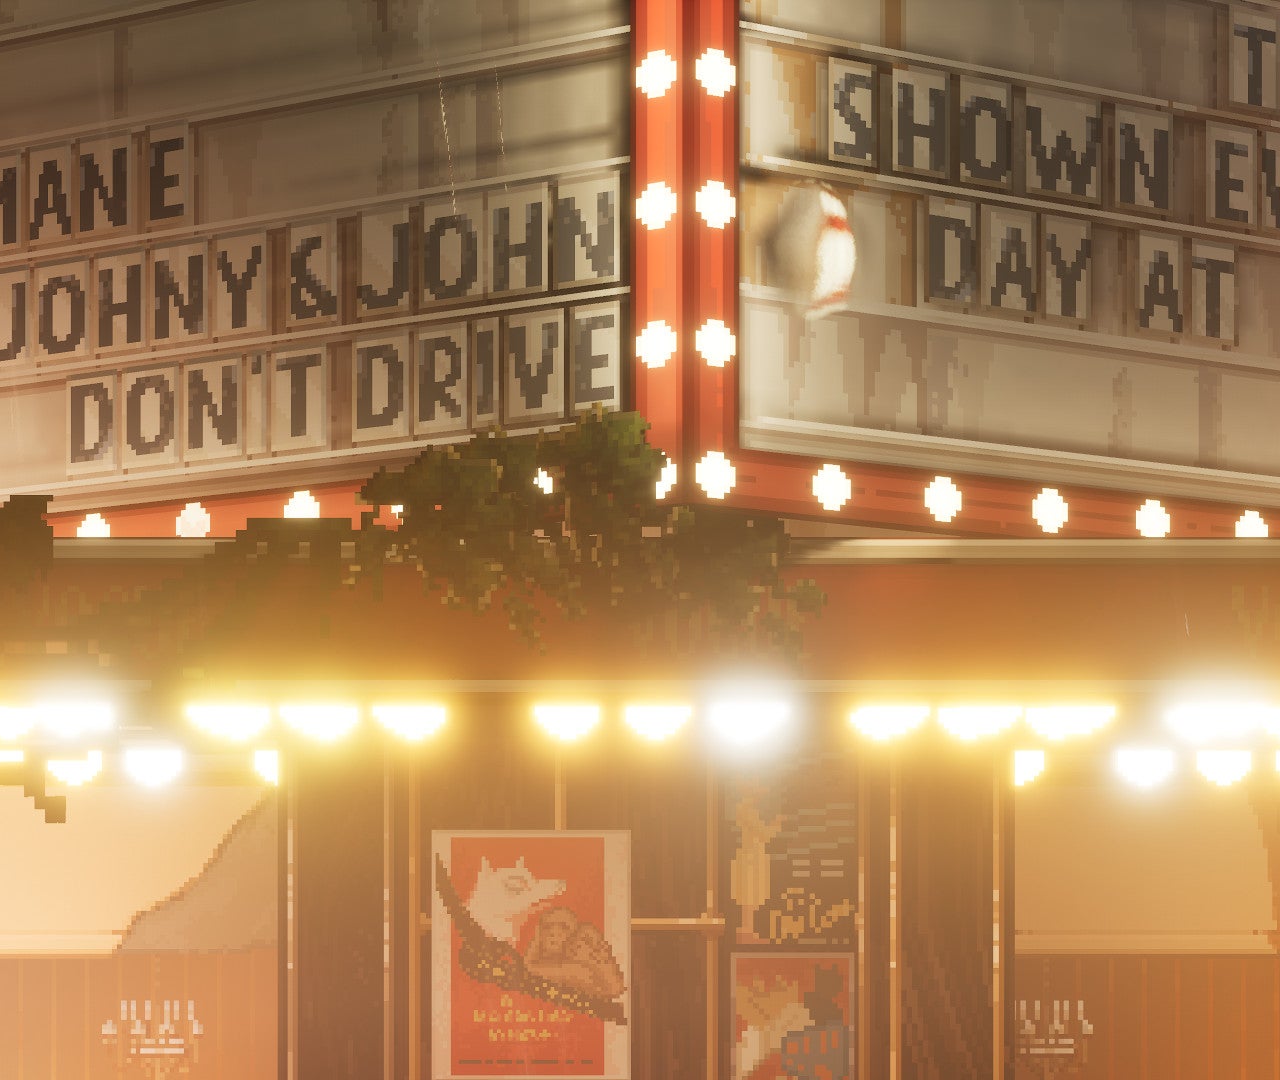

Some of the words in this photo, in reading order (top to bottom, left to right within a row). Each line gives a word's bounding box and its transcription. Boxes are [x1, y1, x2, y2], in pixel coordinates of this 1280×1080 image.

[832, 71, 1170, 210] SHOWN
[356, 191, 617, 312] JOHN
[928, 214, 1092, 319] DAY
[1139, 250, 1235, 337] AT
[70, 354, 321, 464] DON'T
[356, 313, 616, 431] DRIVE
